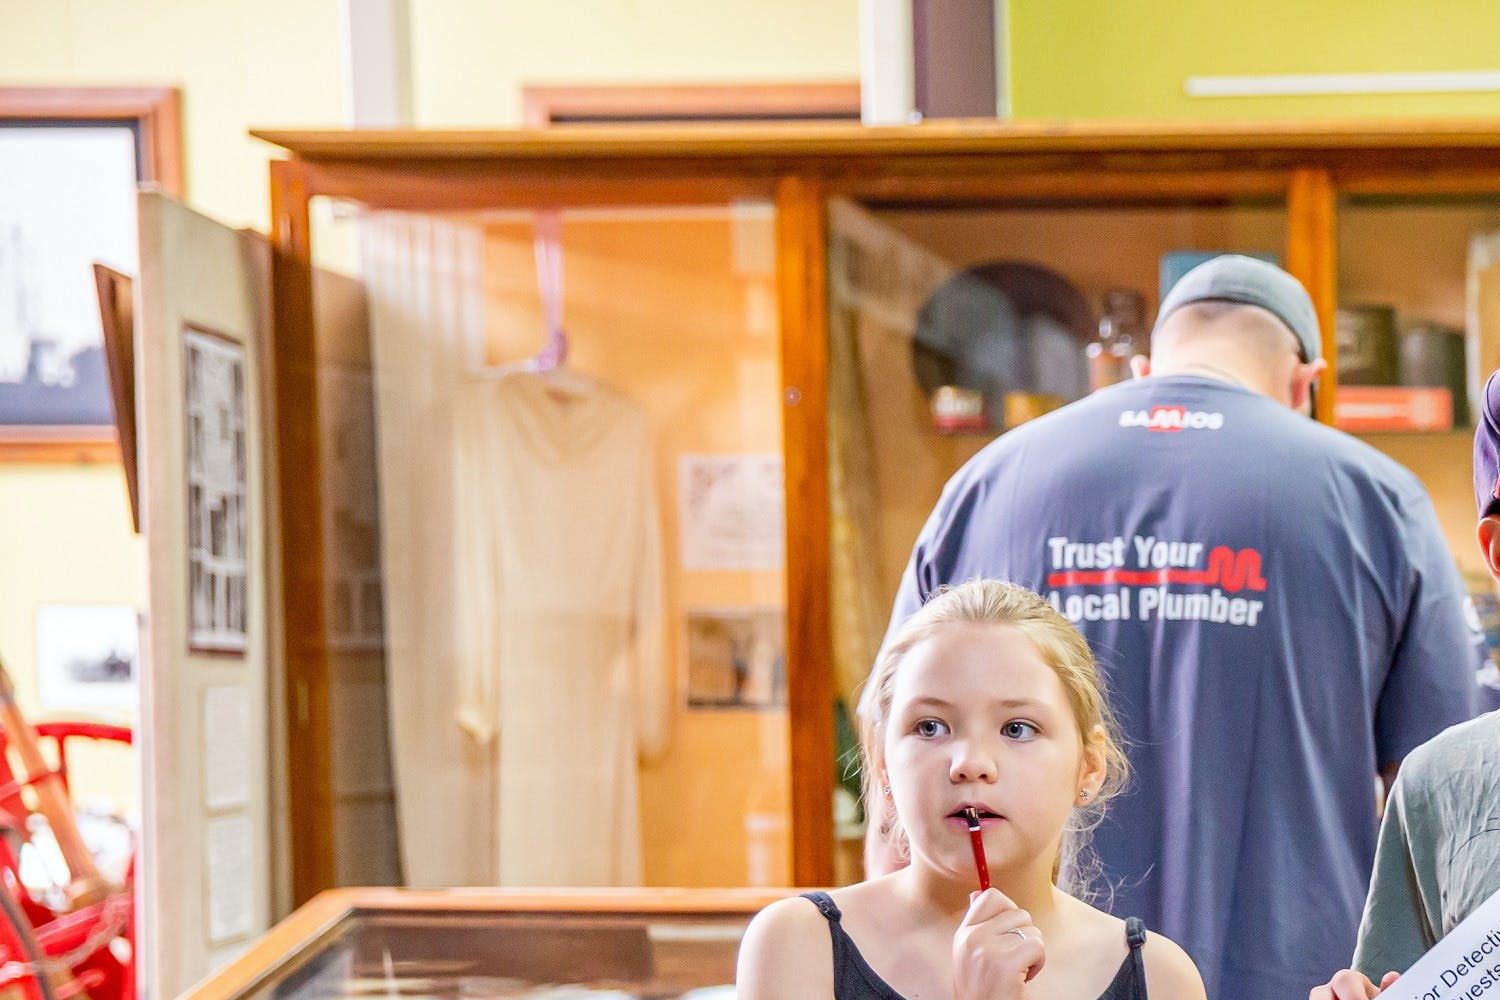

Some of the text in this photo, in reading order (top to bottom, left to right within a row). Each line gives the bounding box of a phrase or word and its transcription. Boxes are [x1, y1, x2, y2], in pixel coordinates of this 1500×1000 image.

[1048, 535, 1204, 569] Trust Your
[1050, 586, 1263, 627] Local Plumber
